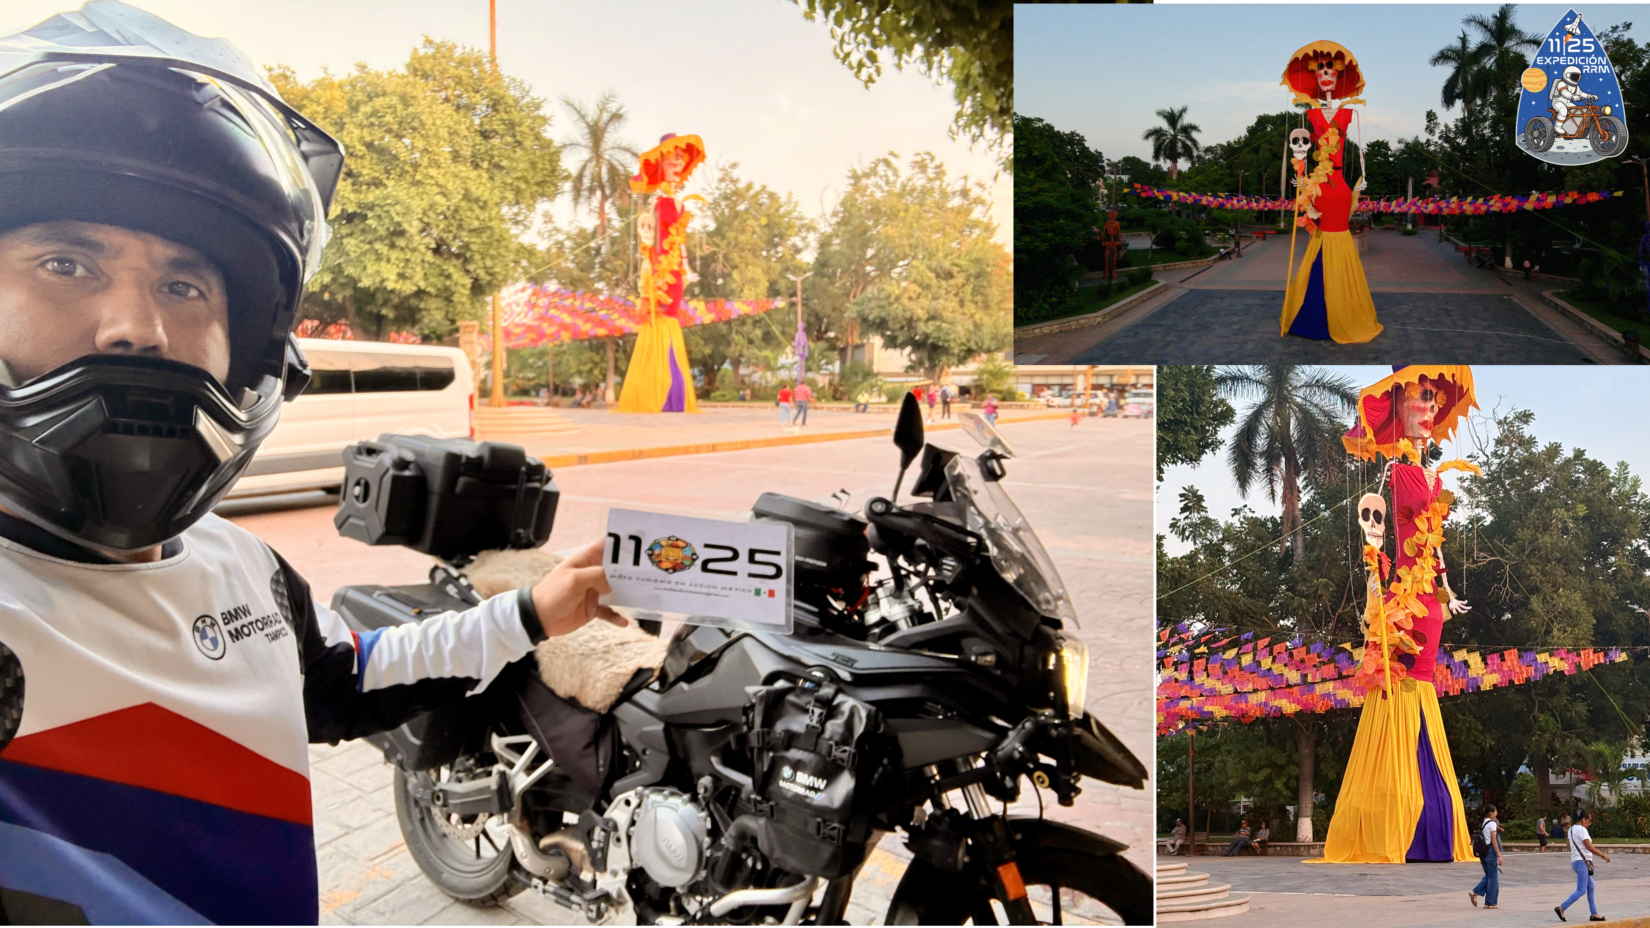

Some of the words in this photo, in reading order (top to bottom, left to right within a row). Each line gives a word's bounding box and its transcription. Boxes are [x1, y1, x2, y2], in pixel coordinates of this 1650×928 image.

[700, 543, 783, 580] 25
[636, 576, 672, 585] TURISMO
[221, 604, 252, 626] BMW
[227, 612, 282, 643] MOTORRAD
[264, 627, 288, 643] TAMPICO
[779, 780, 816, 798] MOTORRAD
[796, 770, 828, 790] BMW
